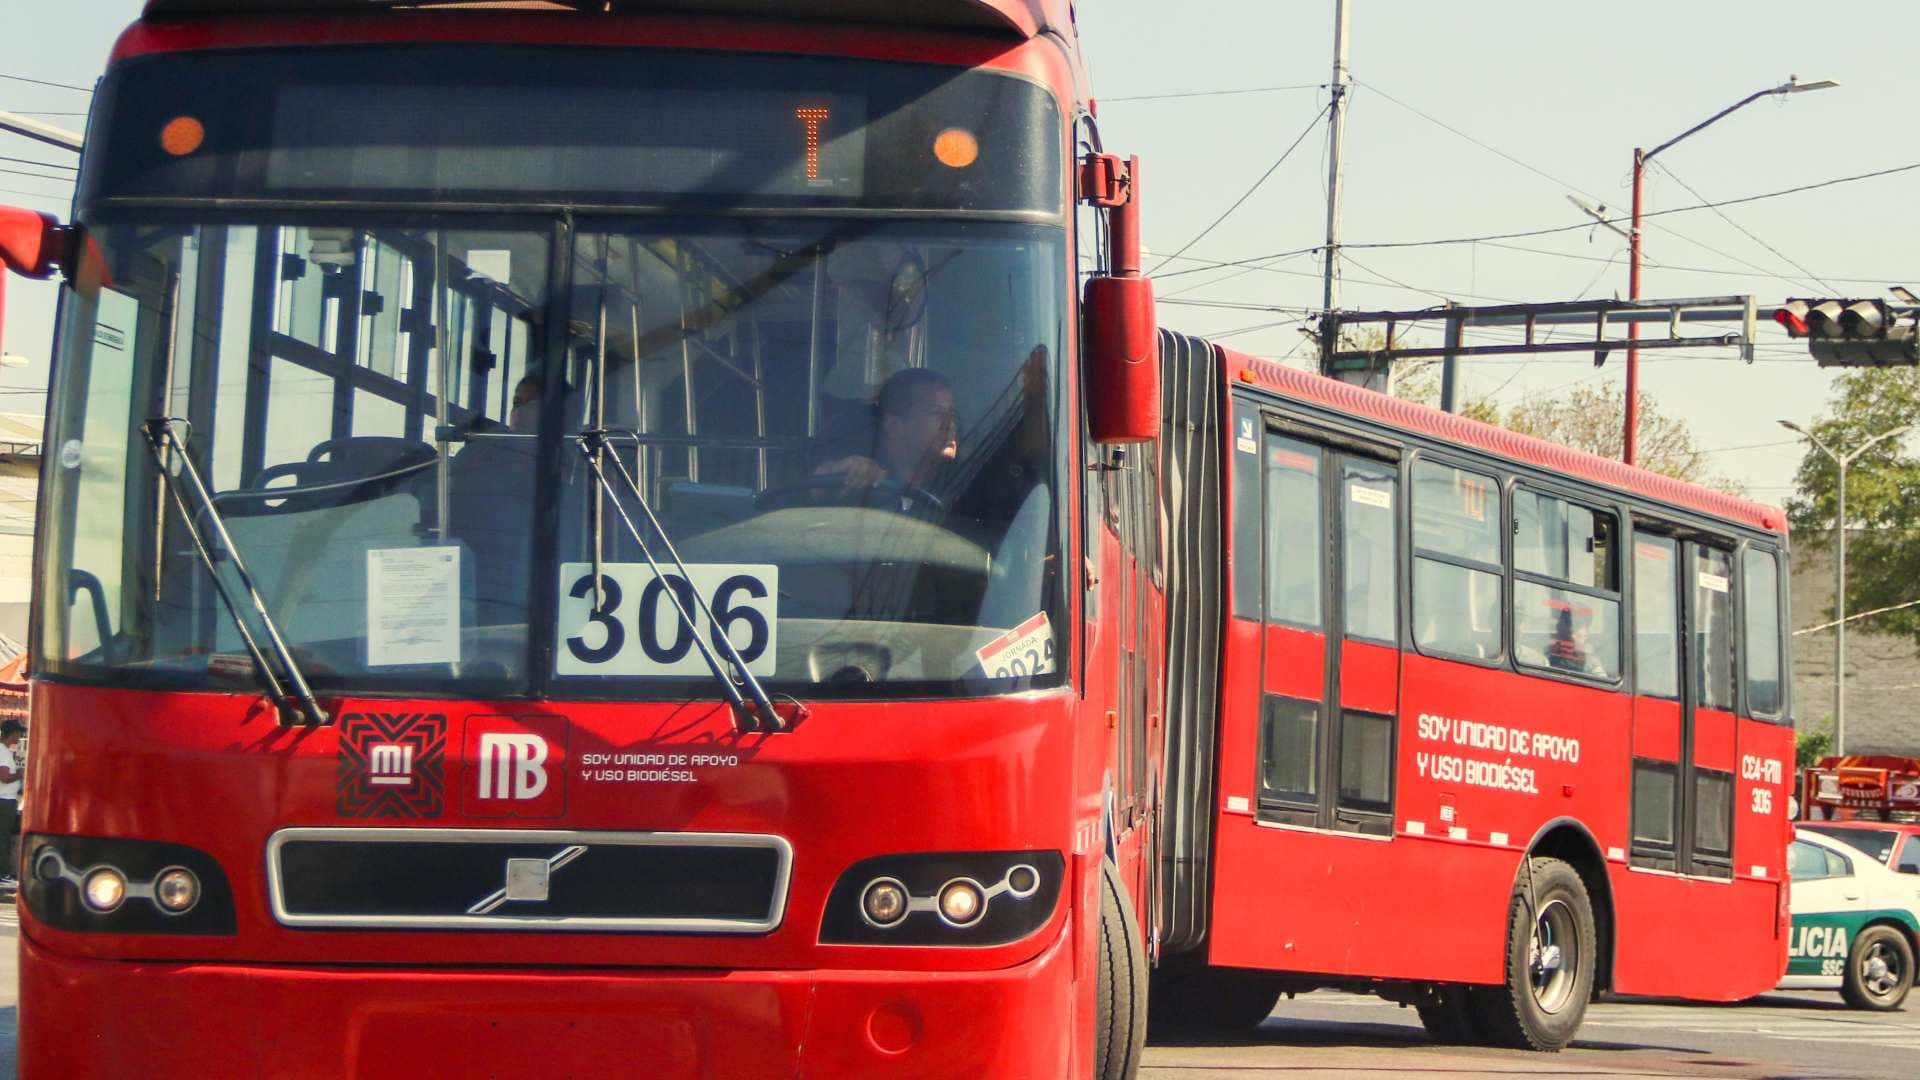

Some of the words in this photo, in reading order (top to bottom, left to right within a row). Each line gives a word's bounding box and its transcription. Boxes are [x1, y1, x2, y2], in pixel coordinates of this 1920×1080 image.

[796, 108, 828, 182] T
[566, 573, 769, 665] 306
[1418, 714, 1450, 742] SOY
[1453, 719, 1507, 751] UNIDAD
[1509, 729, 1530, 755] DE
[1532, 733, 1579, 763] APOYO
[479, 732, 548, 799] MB
[582, 754, 611, 765] SOY
[614, 754, 665, 765] UNIDAD
[668, 754, 687, 766] DE
[691, 755, 738, 767] APOYO
[582, 770, 592, 781] Y
[595, 770, 624, 781] USO
[627, 767, 698, 782] BIODIÉSEL
[1416, 752, 1429, 777] Y
[1431, 754, 1462, 782] USO
[1465, 758, 1539, 794] BIODIÉSEL
[1751, 788, 1772, 815] 306
[1788, 926, 1848, 957] LICIA
[1822, 959, 1845, 977] SSC
